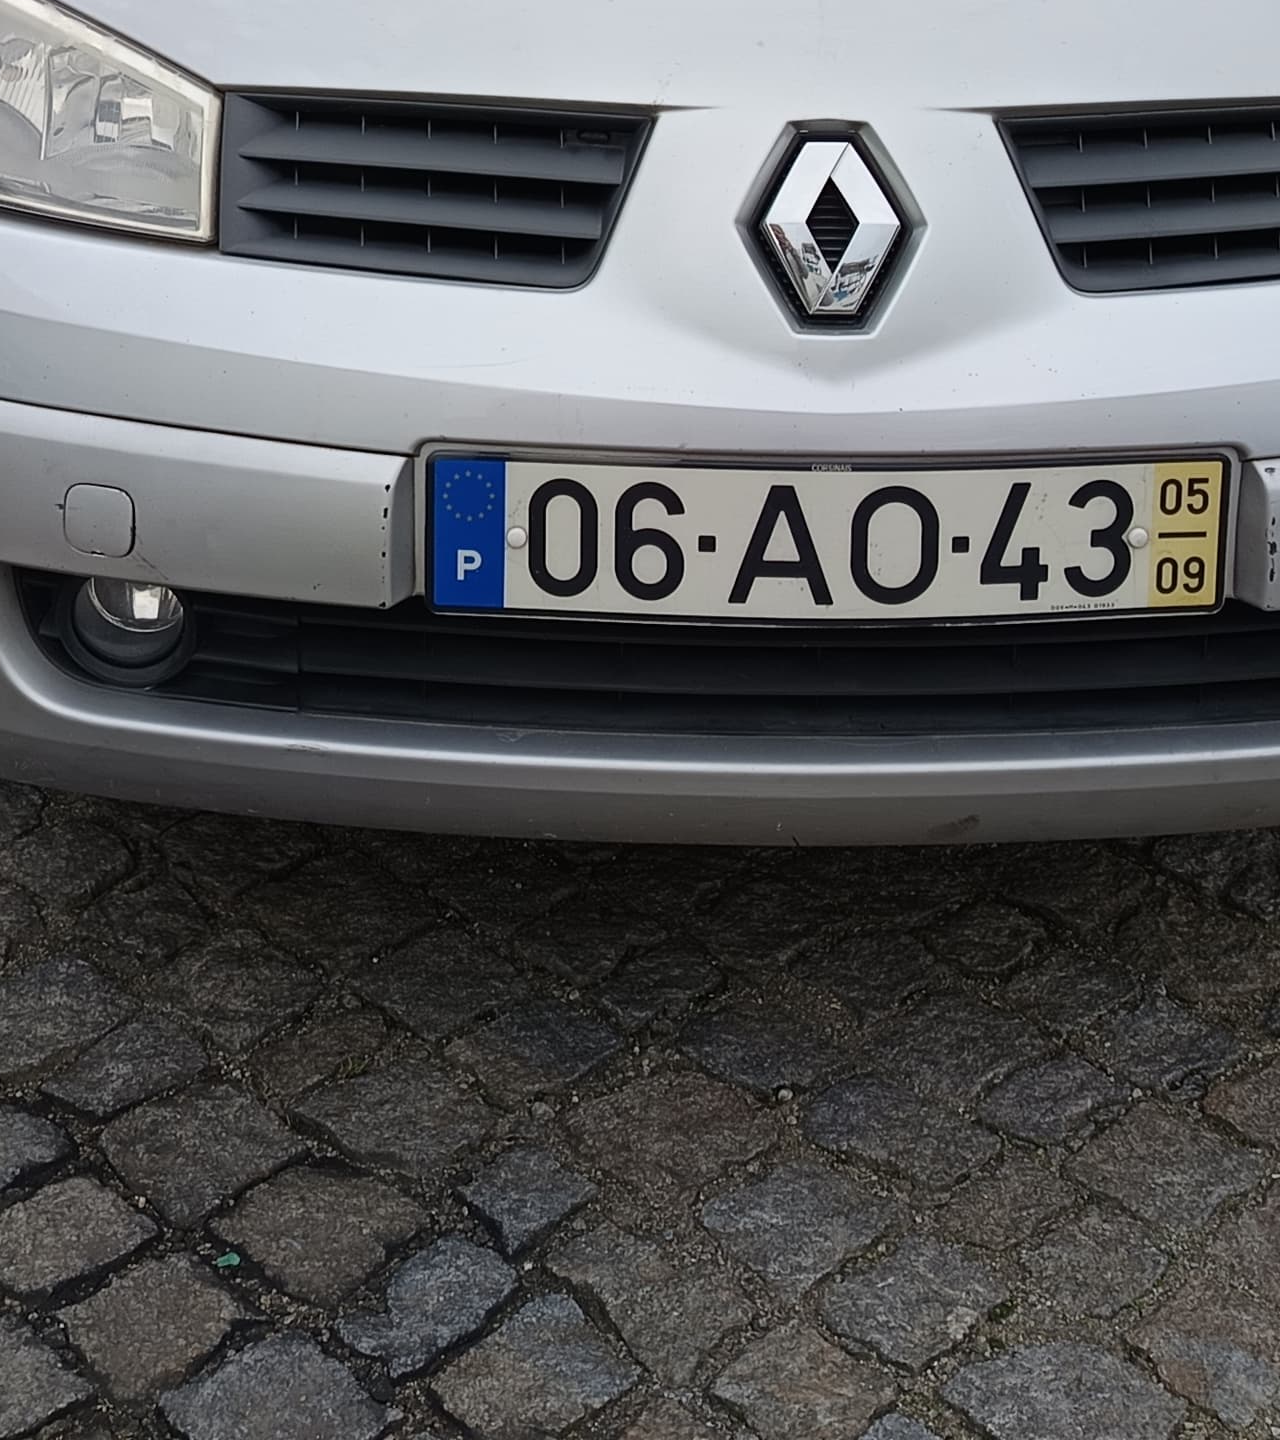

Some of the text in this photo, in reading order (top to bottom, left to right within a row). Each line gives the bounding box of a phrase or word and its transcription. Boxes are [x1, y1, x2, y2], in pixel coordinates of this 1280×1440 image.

[1160, 477, 1209, 515] 05
[456, 549, 482, 581] P
[1156, 556, 1205, 594] 09
